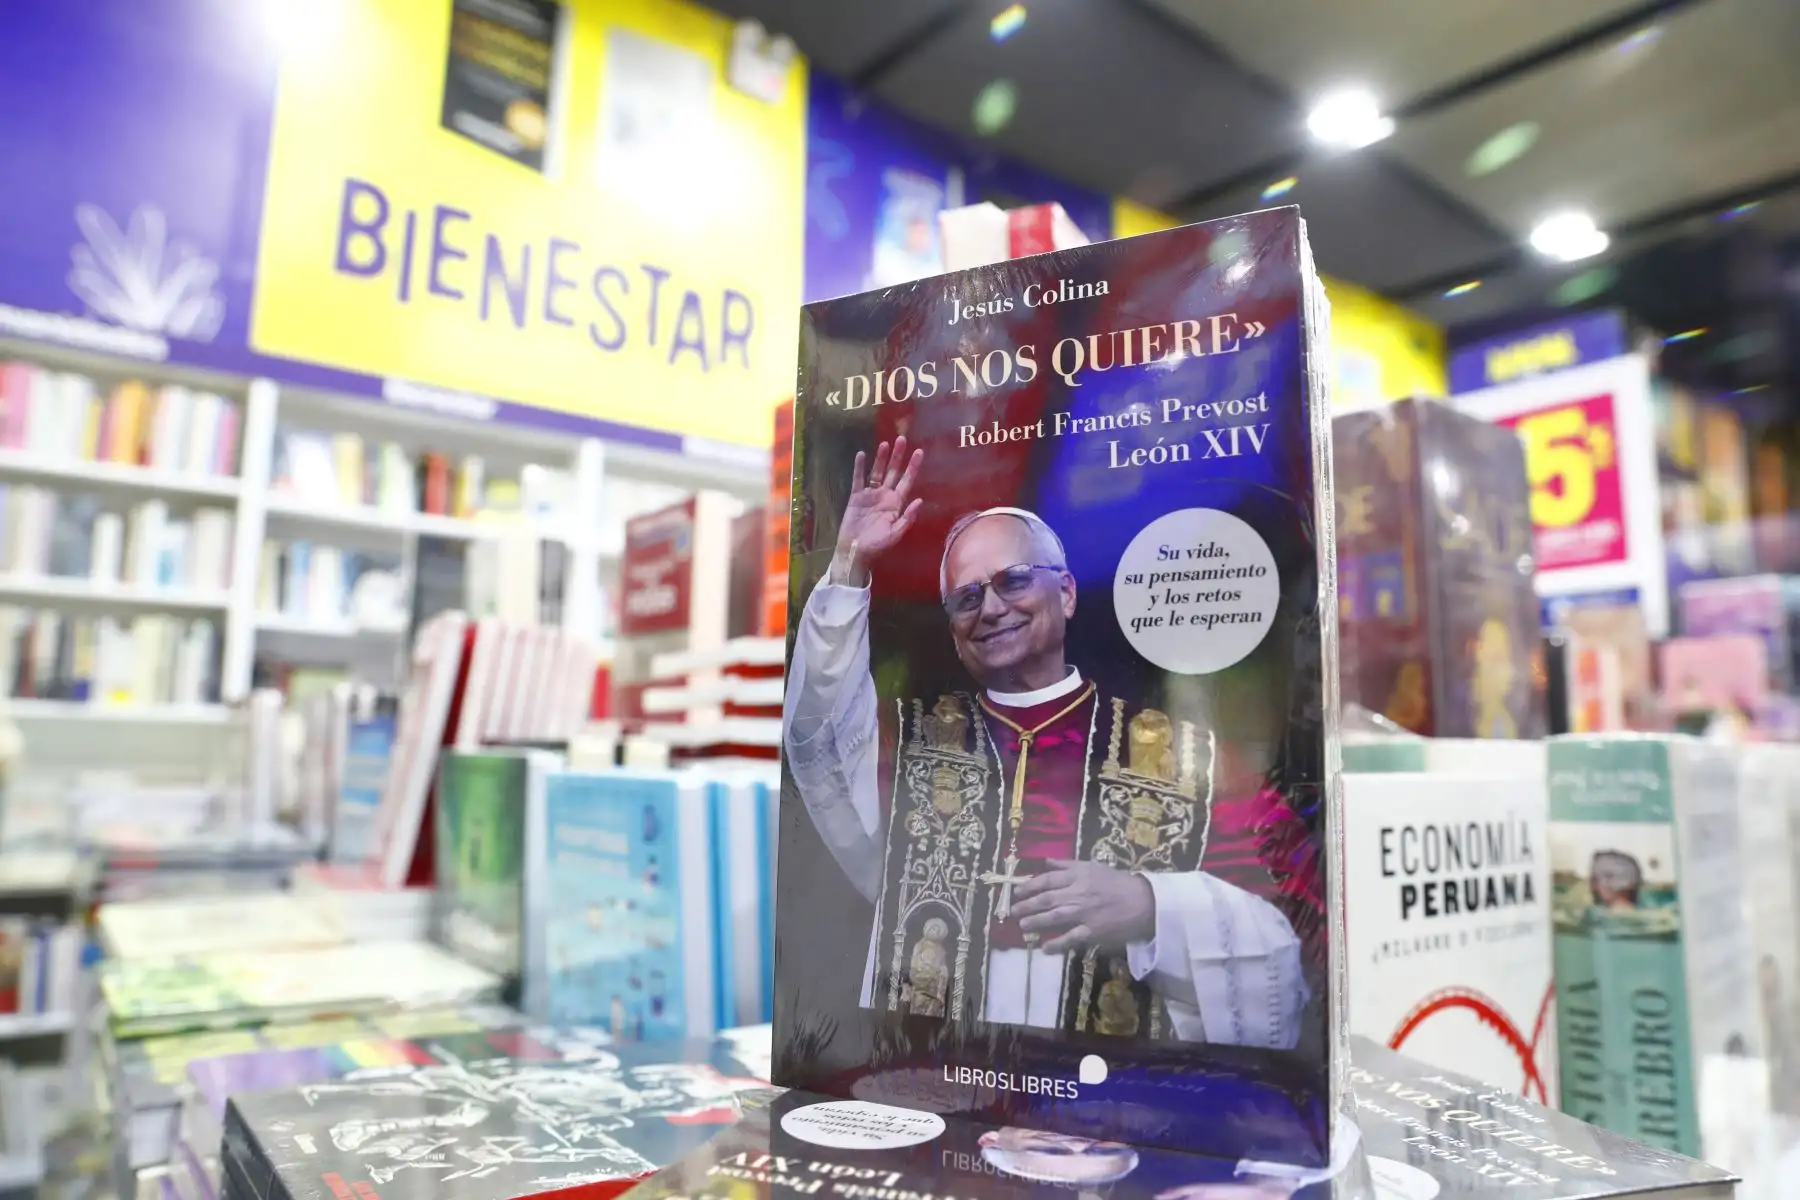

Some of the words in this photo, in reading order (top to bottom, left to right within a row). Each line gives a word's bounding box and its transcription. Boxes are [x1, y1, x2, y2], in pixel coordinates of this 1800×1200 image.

[334, 177, 755, 373] BIENESTAR
[948, 291, 1014, 326] Jesús
[1022, 278, 1110, 309] Colina
[825, 361, 938, 411] «DIOS
[950, 343, 1039, 394] NOS
[1051, 312, 1267, 388] QUIERE»
[958, 421, 1044, 449] Robert
[1052, 406, 1152, 438] Francis
[1160, 390, 1269, 424] Prevost
[1108, 439, 1191, 469] León
[1200, 423, 1272, 460] XIV
[1157, 544, 1180, 562] Su
[1186, 541, 1231, 560] vida,
[1124, 573, 1144, 586] su
[1148, 564, 1267, 589] pensamiento
[1147, 594, 1160, 611] y
[1164, 588, 1190, 605] los
[1194, 588, 1242, 603] retos
[1131, 615, 1164, 633] que
[1168, 610, 1185, 627] le
[1190, 611, 1262, 630] esperan
[1401, 873, 1535, 920] PERUANA
[944, 1064, 1079, 1099] LIBROSLIBRES
[1630, 987, 1681, 1151] REBRO
[718, 1152, 802, 1173] XIV
[808, 1161, 903, 1187] León
